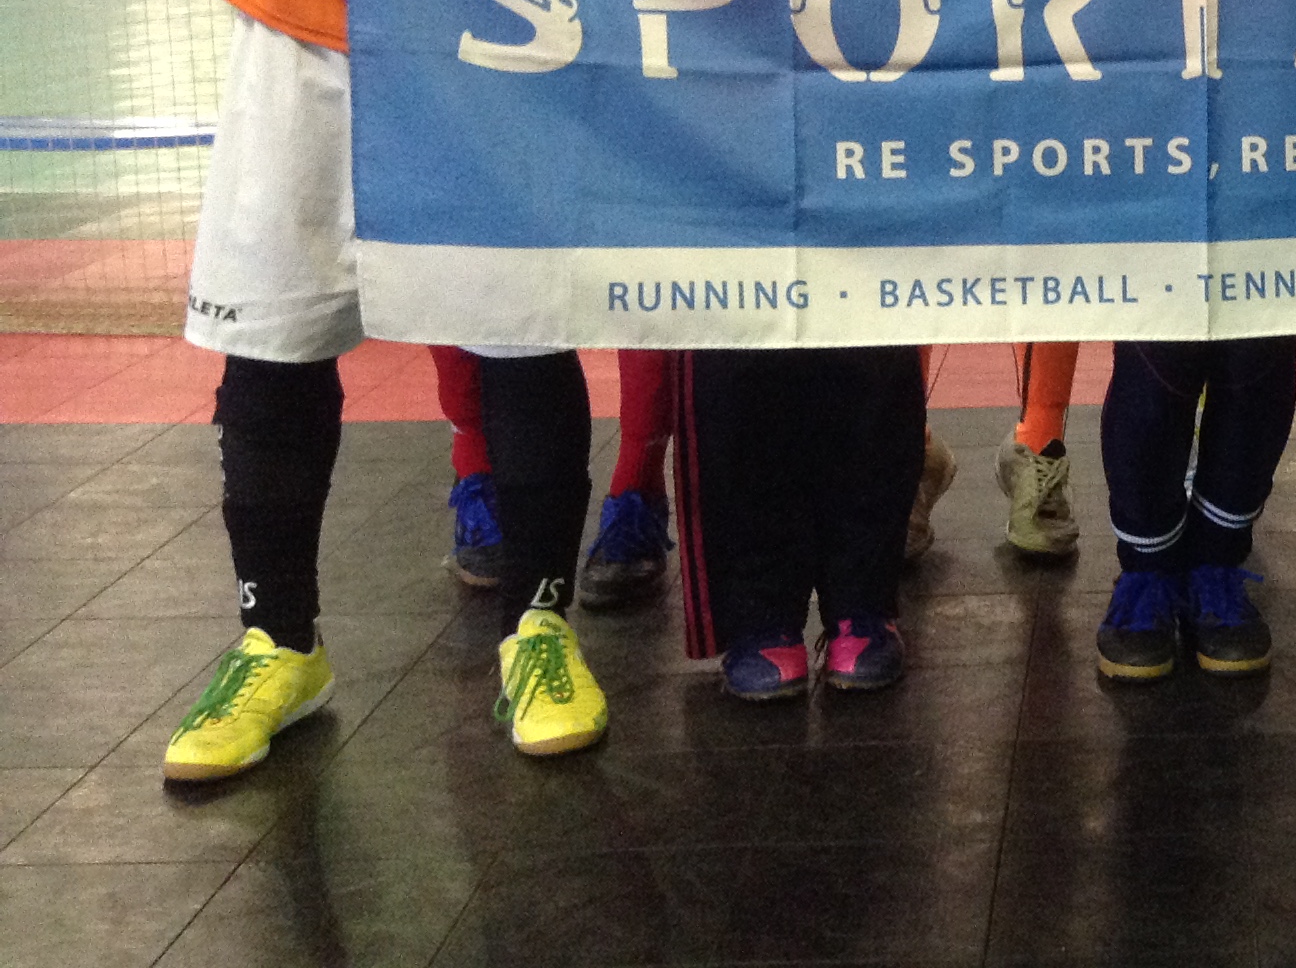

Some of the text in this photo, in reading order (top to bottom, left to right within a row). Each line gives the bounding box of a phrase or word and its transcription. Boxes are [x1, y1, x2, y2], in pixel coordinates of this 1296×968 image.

[834, 139, 907, 180] RE
[188, 294, 238, 323] LETA
[608, 280, 810, 312] RUNNING
[880, 274, 1139, 308] BASKETBALL
